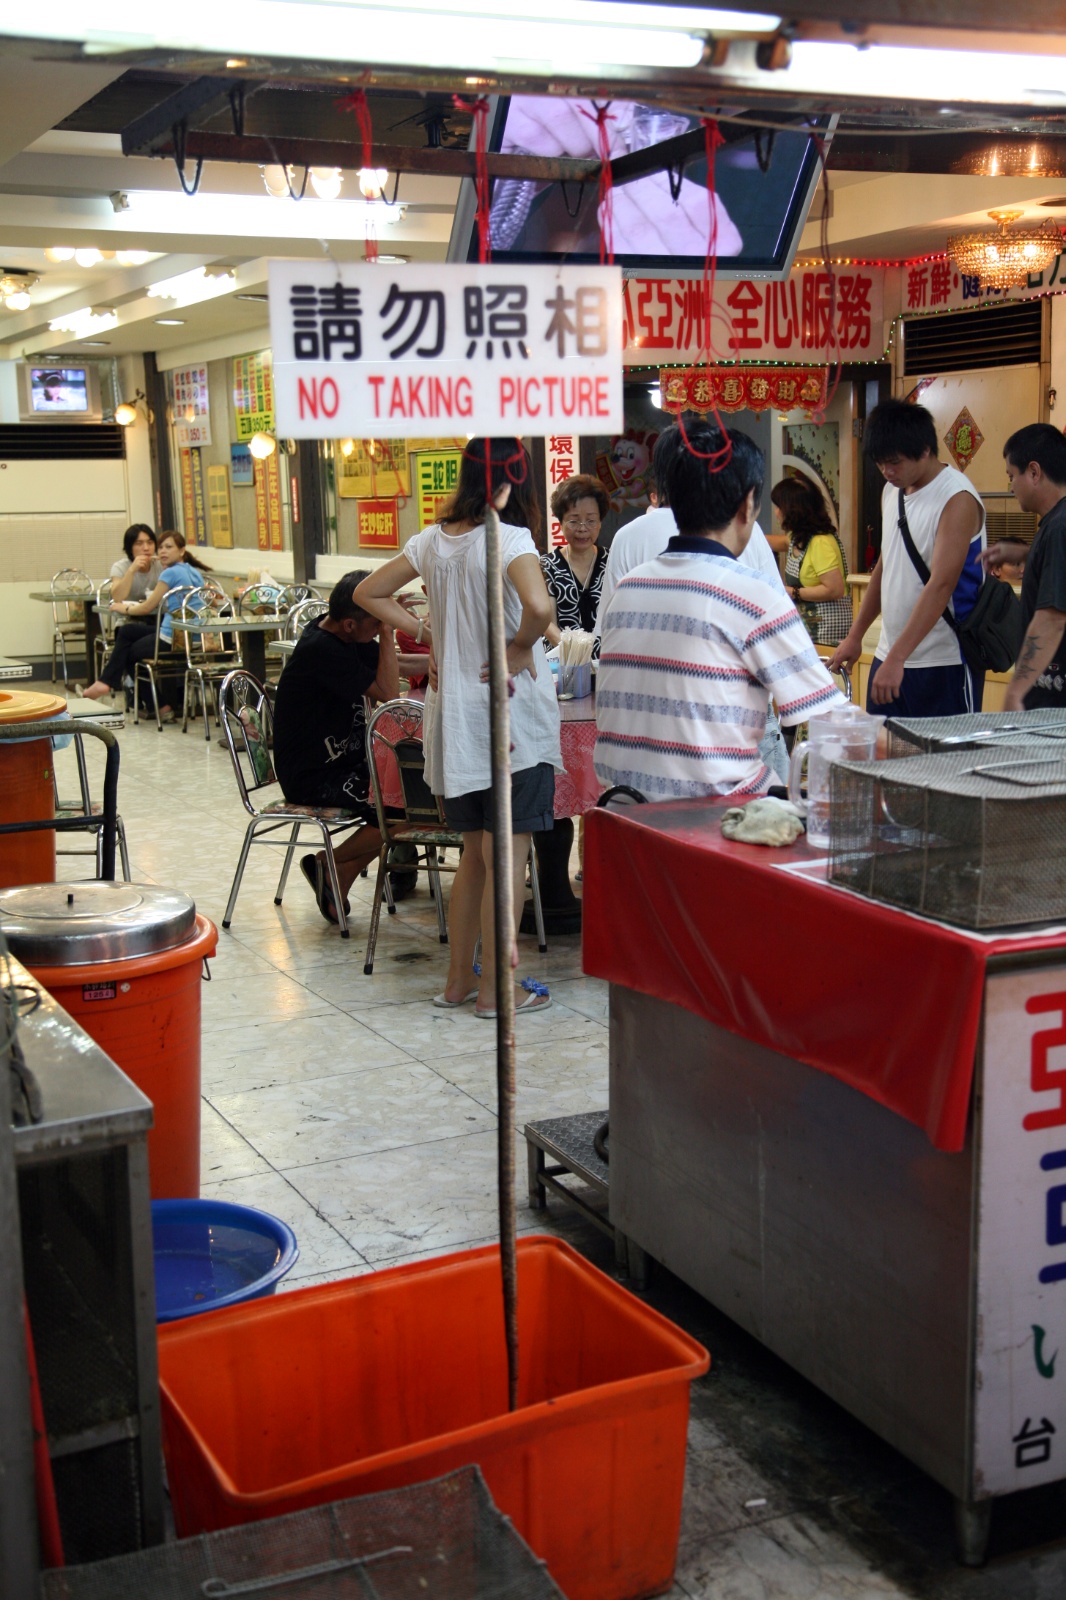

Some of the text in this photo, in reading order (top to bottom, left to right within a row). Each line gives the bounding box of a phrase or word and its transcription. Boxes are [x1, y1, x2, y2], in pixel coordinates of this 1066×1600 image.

[289, 282, 608, 361] 請勿照相
[297, 376, 340, 419] NO
[368, 376, 473, 418] TAKING
[500, 376, 610, 417] PICTURE
[695, 378, 797, 402] 恭喜發財
